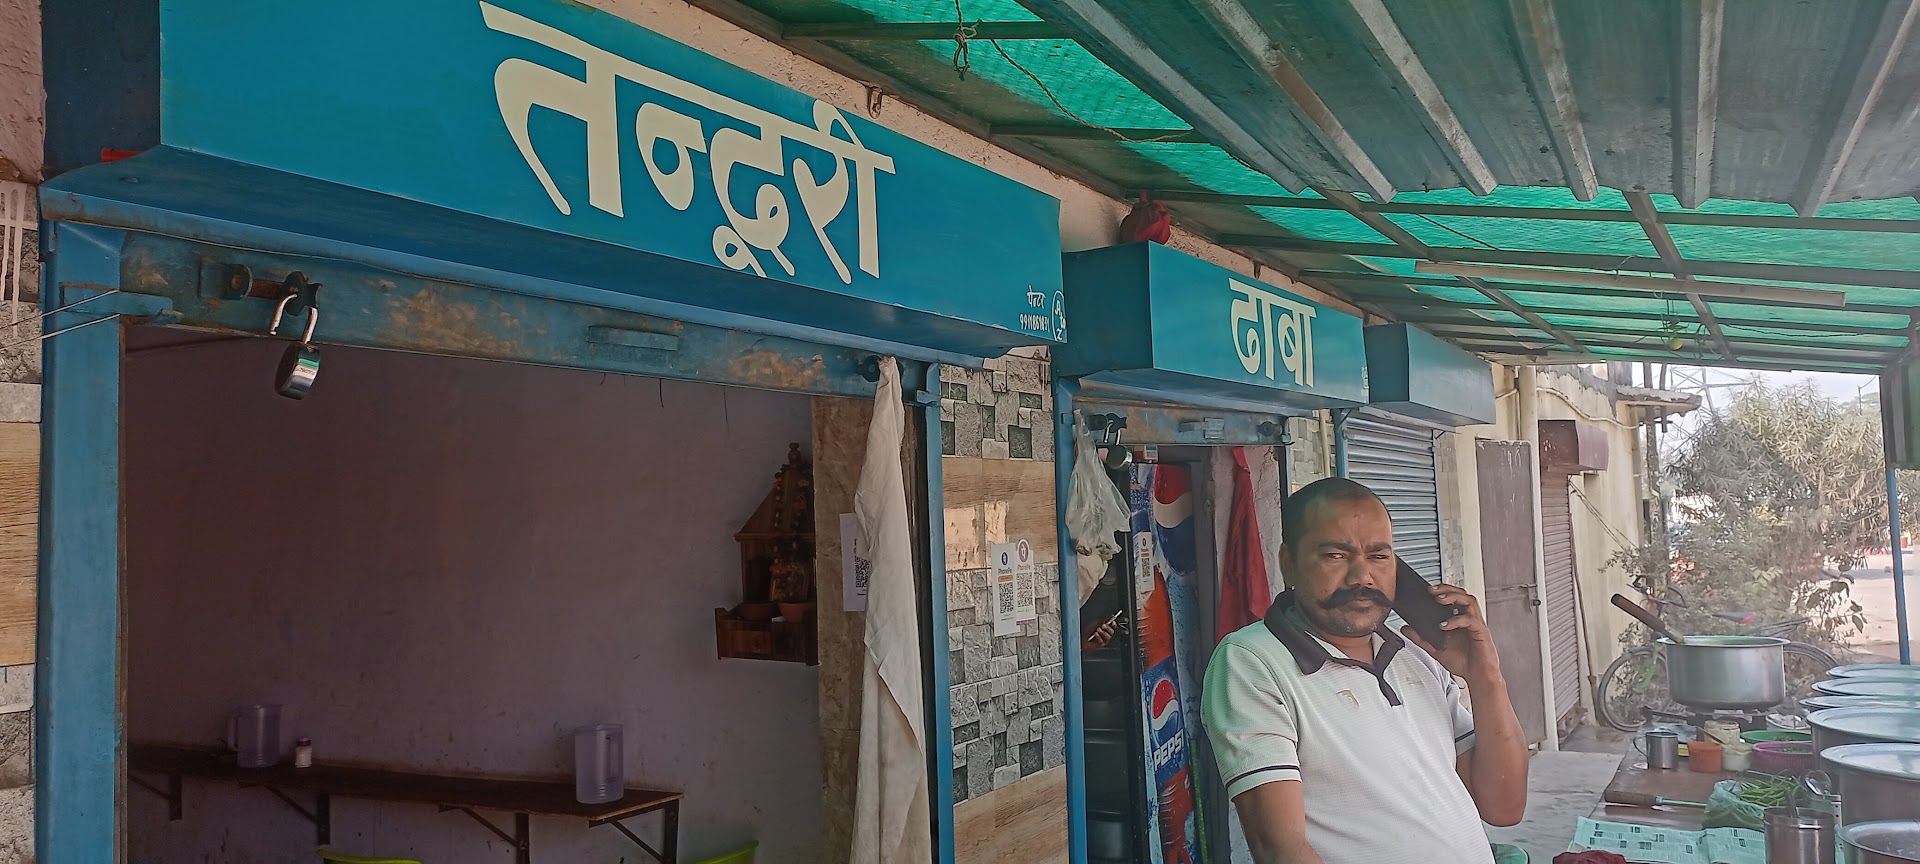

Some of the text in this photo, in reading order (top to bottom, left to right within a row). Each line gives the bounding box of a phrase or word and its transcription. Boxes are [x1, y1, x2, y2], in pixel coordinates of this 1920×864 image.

[478, 1, 896, 284] तन्दूरी
[1229, 277, 1317, 388] ढाबा
[1154, 729, 1184, 772] PEPSI
